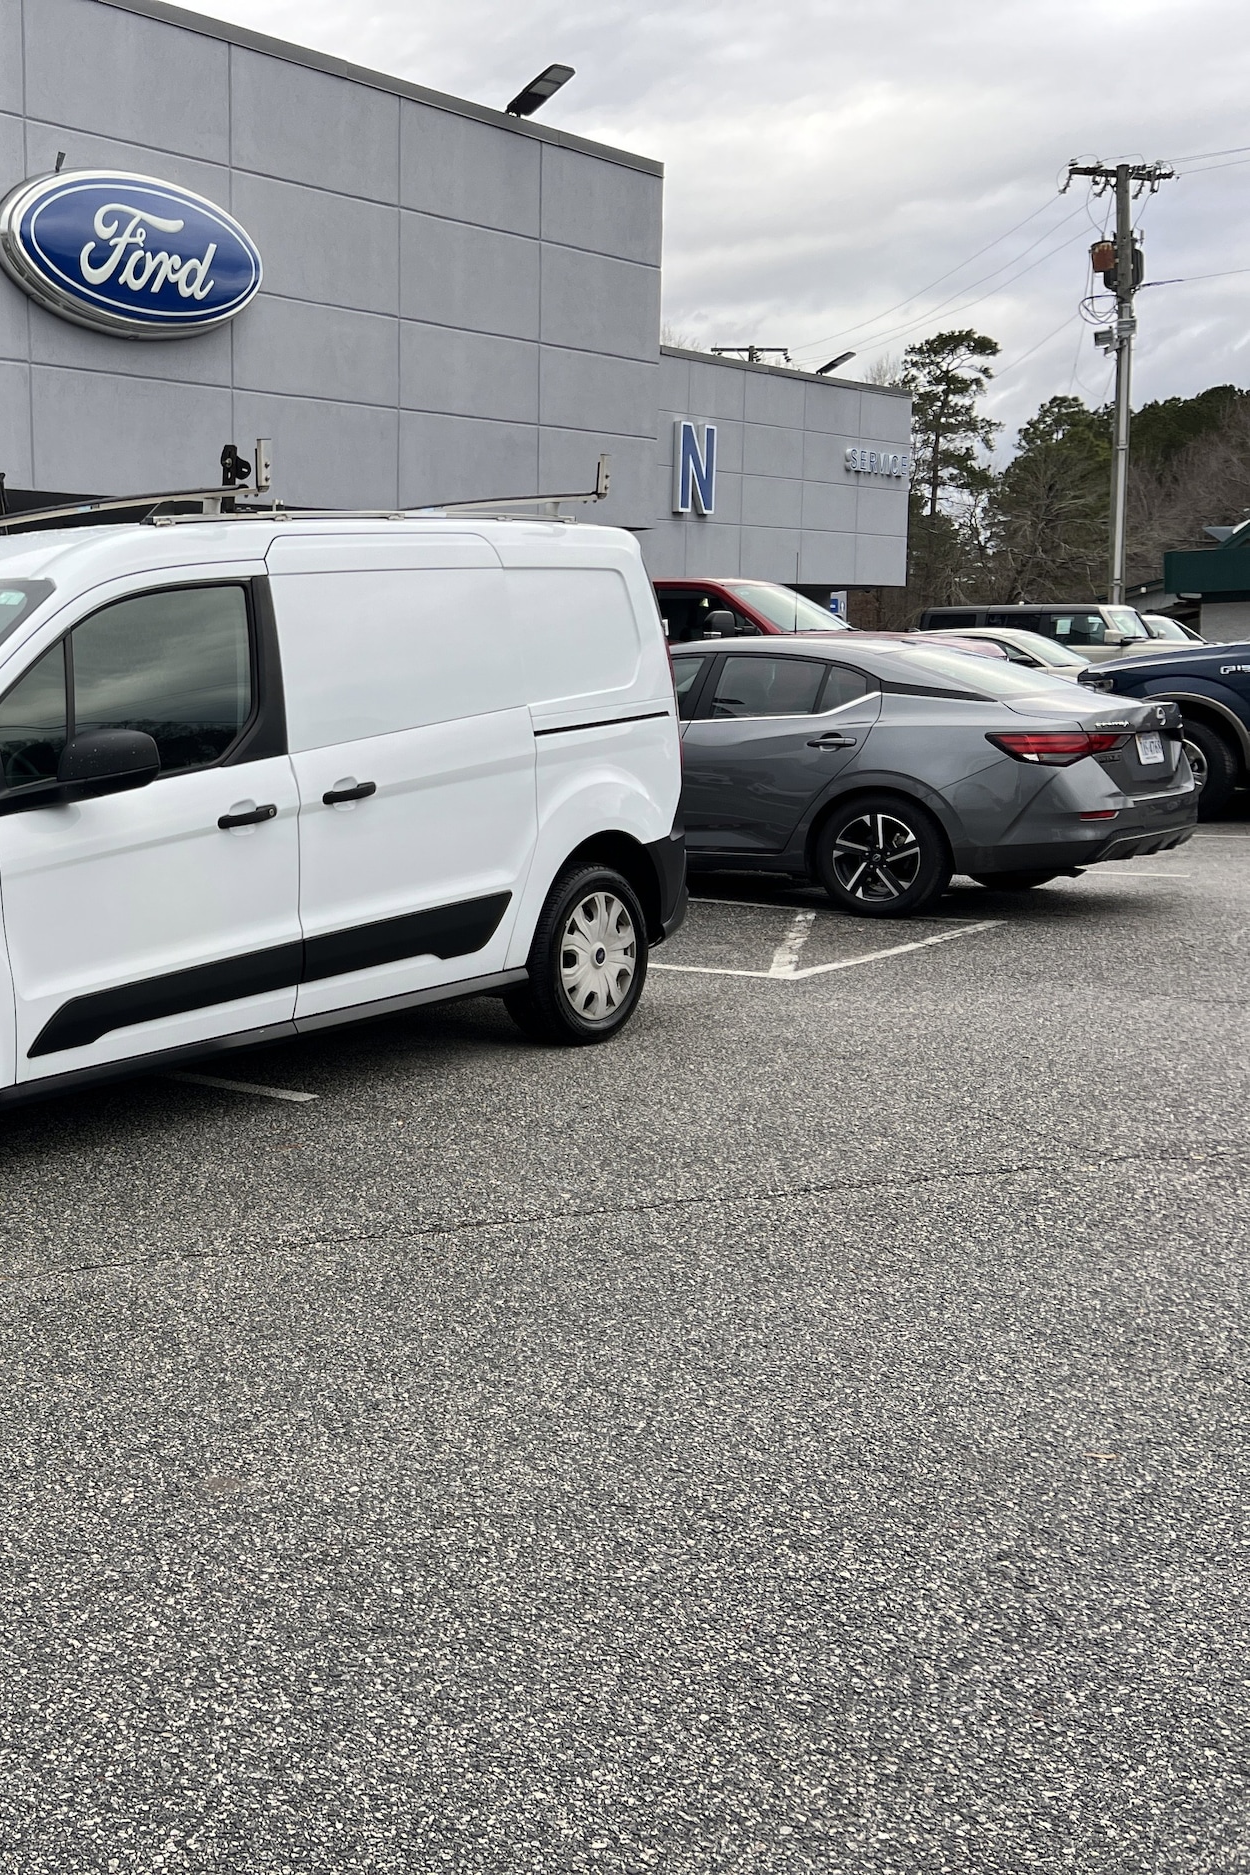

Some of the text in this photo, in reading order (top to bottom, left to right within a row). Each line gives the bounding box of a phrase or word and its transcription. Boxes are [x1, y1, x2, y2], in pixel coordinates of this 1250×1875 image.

[80, 202, 217, 300] Ford
[675, 420, 717, 514] N
[848, 447, 909, 477] SERVICE
